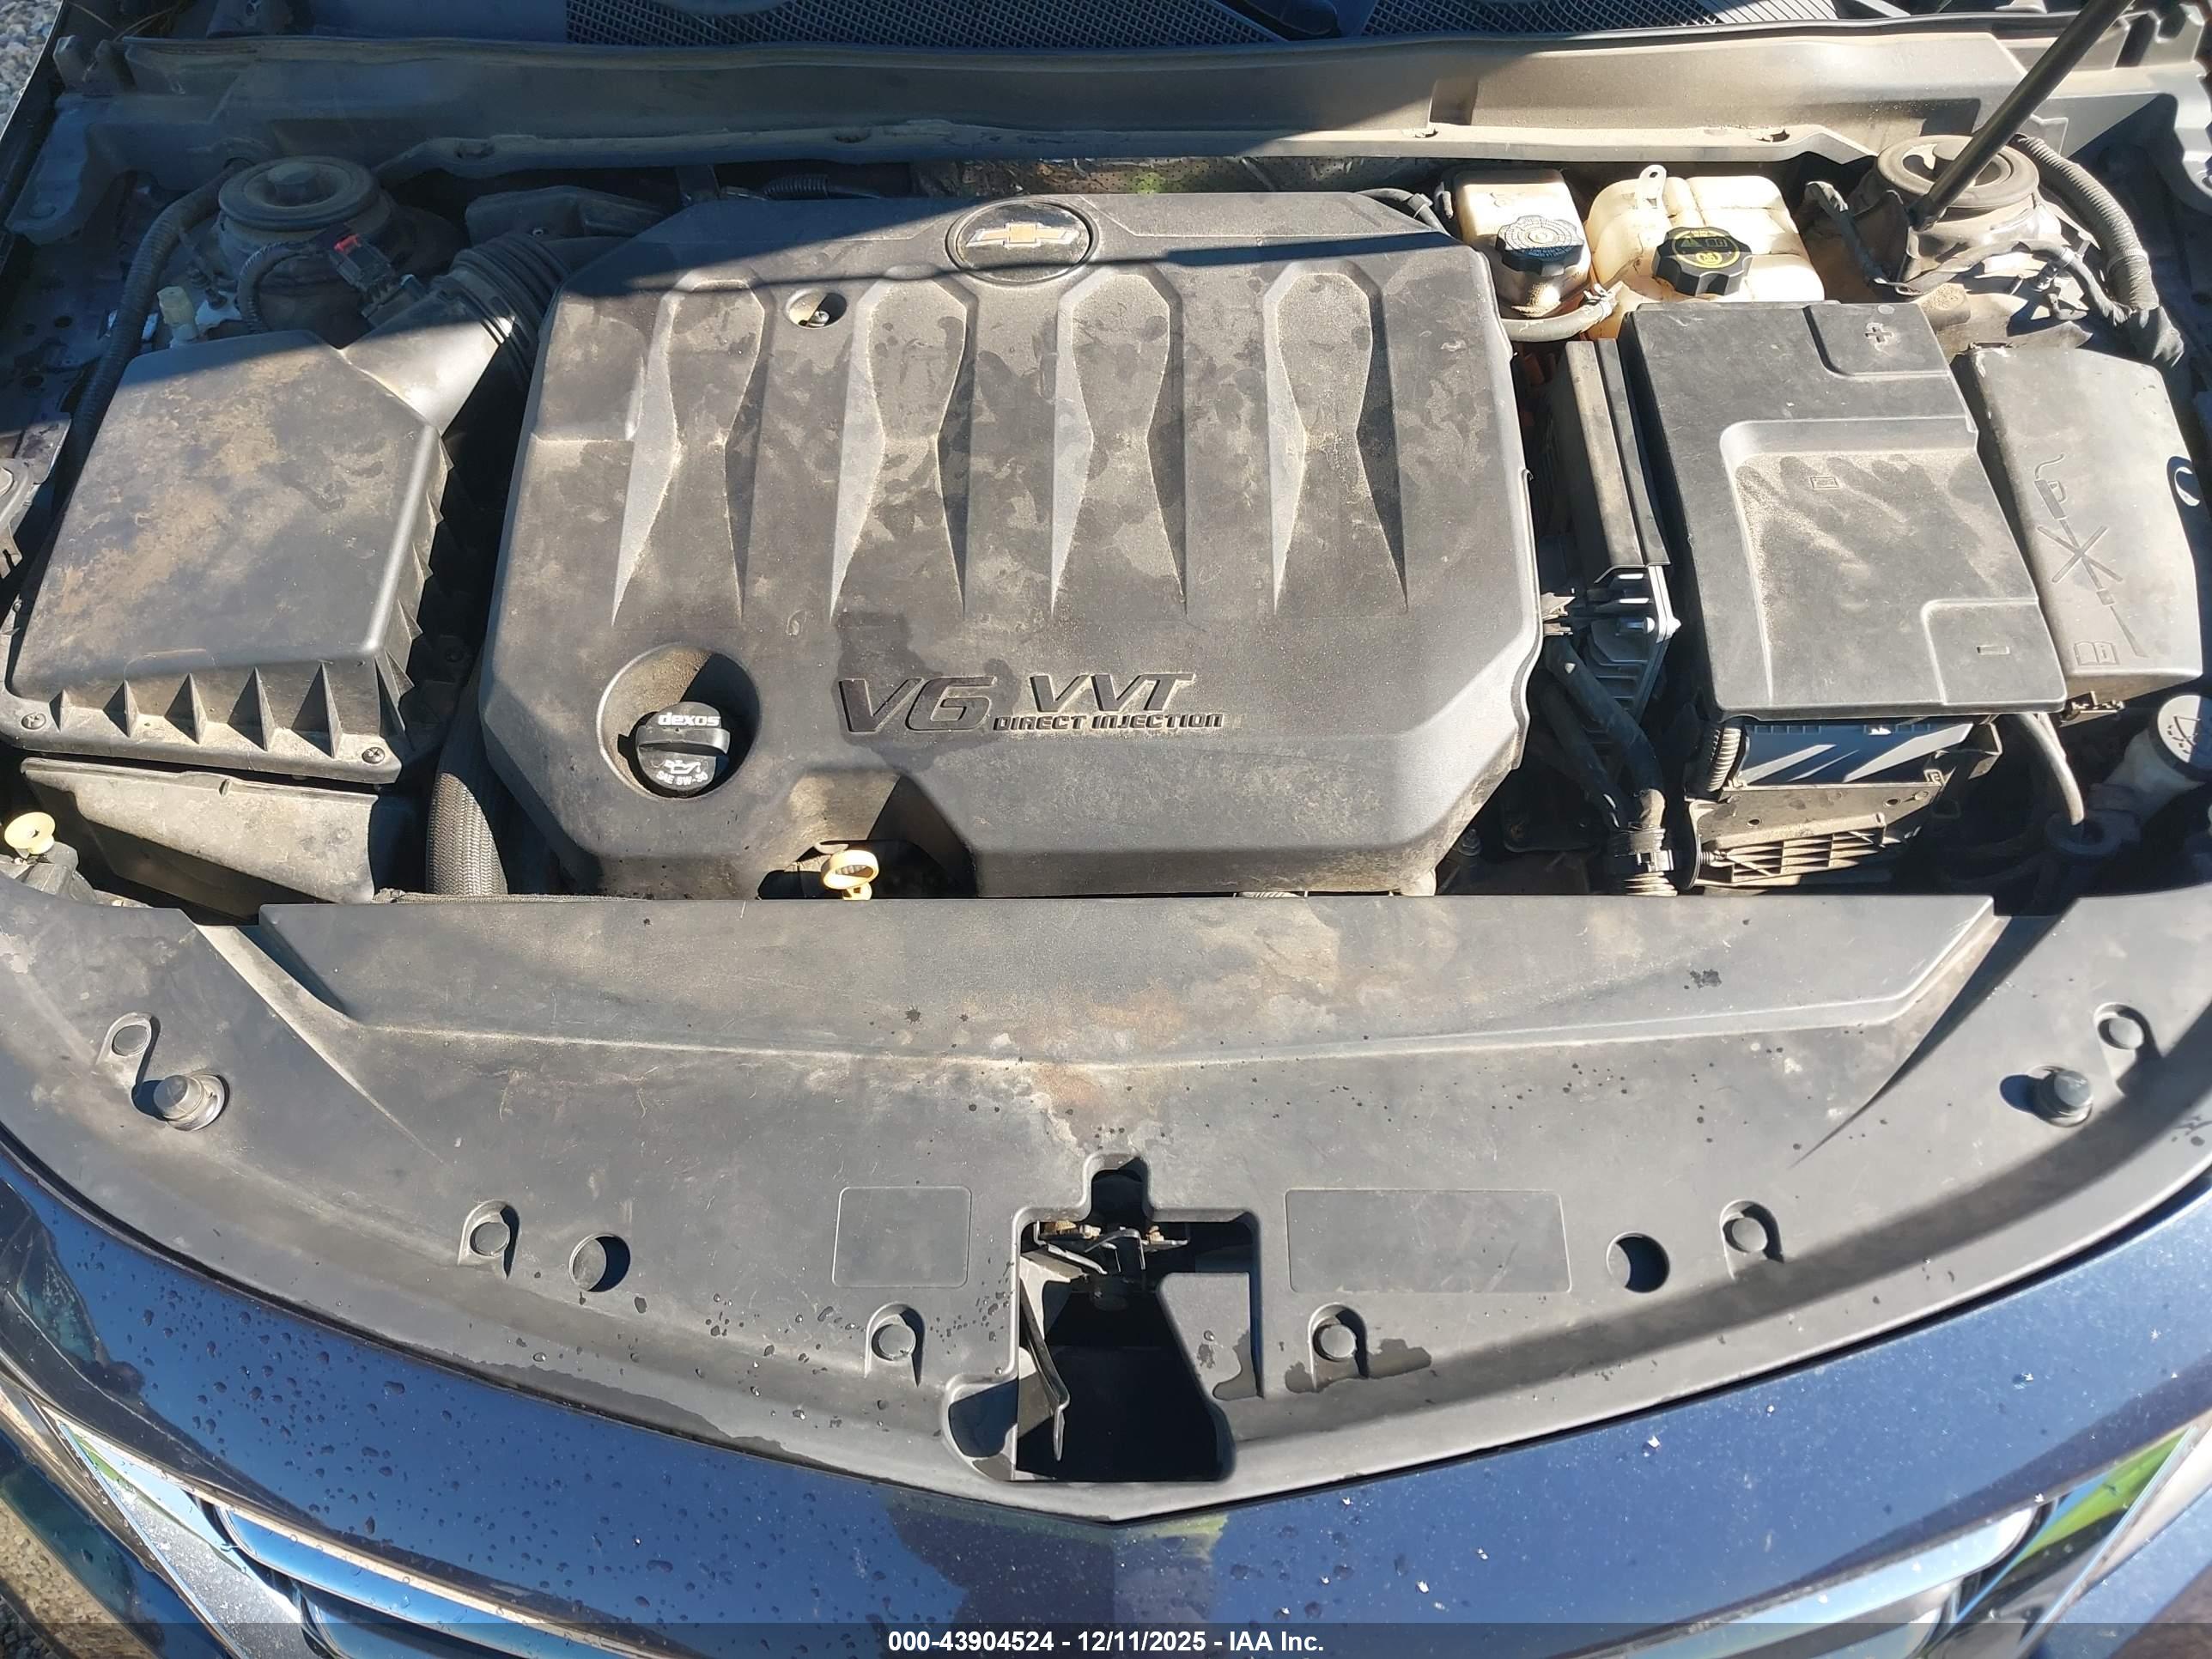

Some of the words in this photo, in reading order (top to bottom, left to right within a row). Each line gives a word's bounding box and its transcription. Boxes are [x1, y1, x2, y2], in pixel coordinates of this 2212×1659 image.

[839, 676, 996, 733] V6
[1029, 672, 1197, 714] VVT
[658, 712, 721, 726] dexos
[993, 714, 1087, 732] DIRECT
[1091, 713, 1224, 731] INJECTION
[656, 770, 675, 785] SAE
[676, 772, 708, 786] 5W-30
